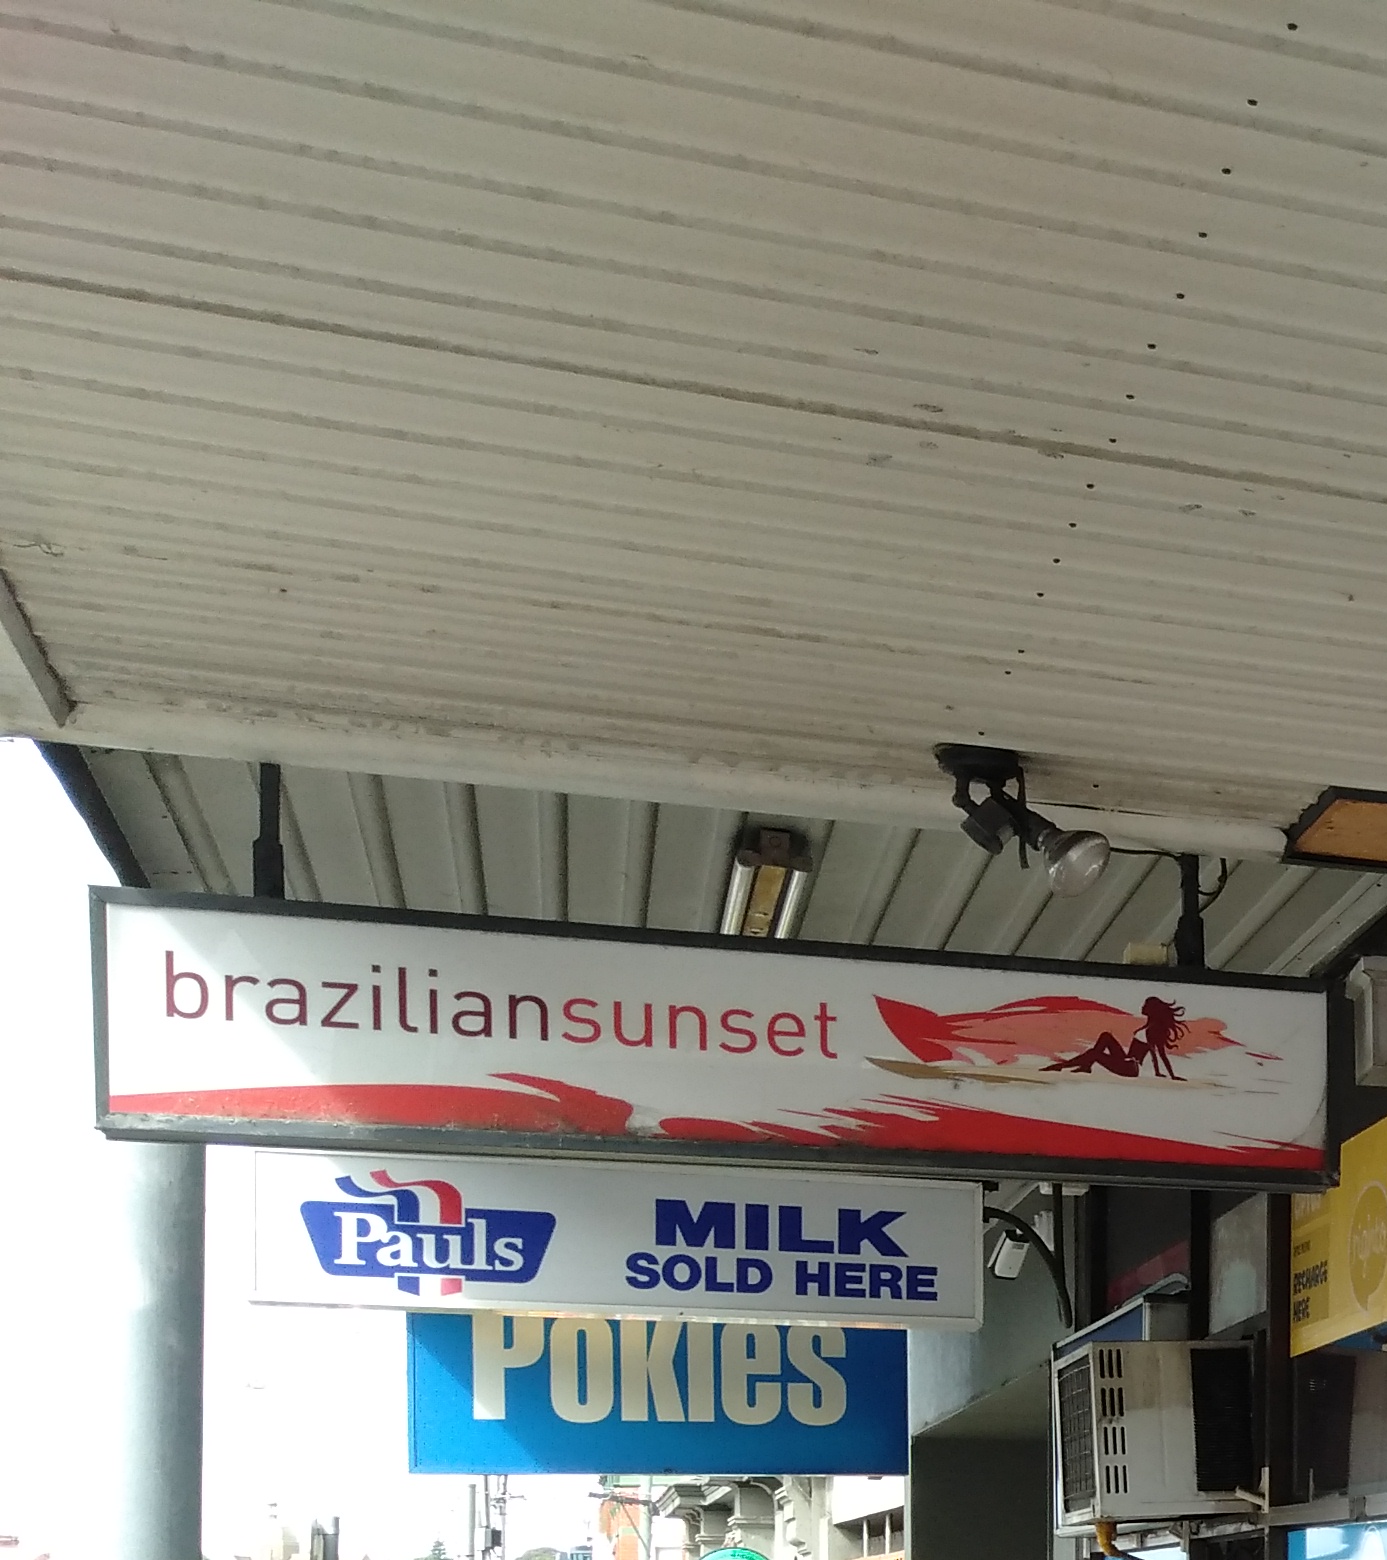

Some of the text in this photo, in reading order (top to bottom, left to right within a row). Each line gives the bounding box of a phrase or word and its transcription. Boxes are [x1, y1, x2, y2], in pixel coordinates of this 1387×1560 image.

[163, 950, 839, 1060] braziliansunset
[333, 1210, 525, 1272] Pauls
[655, 1198, 911, 1259] MILK
[625, 1253, 939, 1301] SOLD HERE
